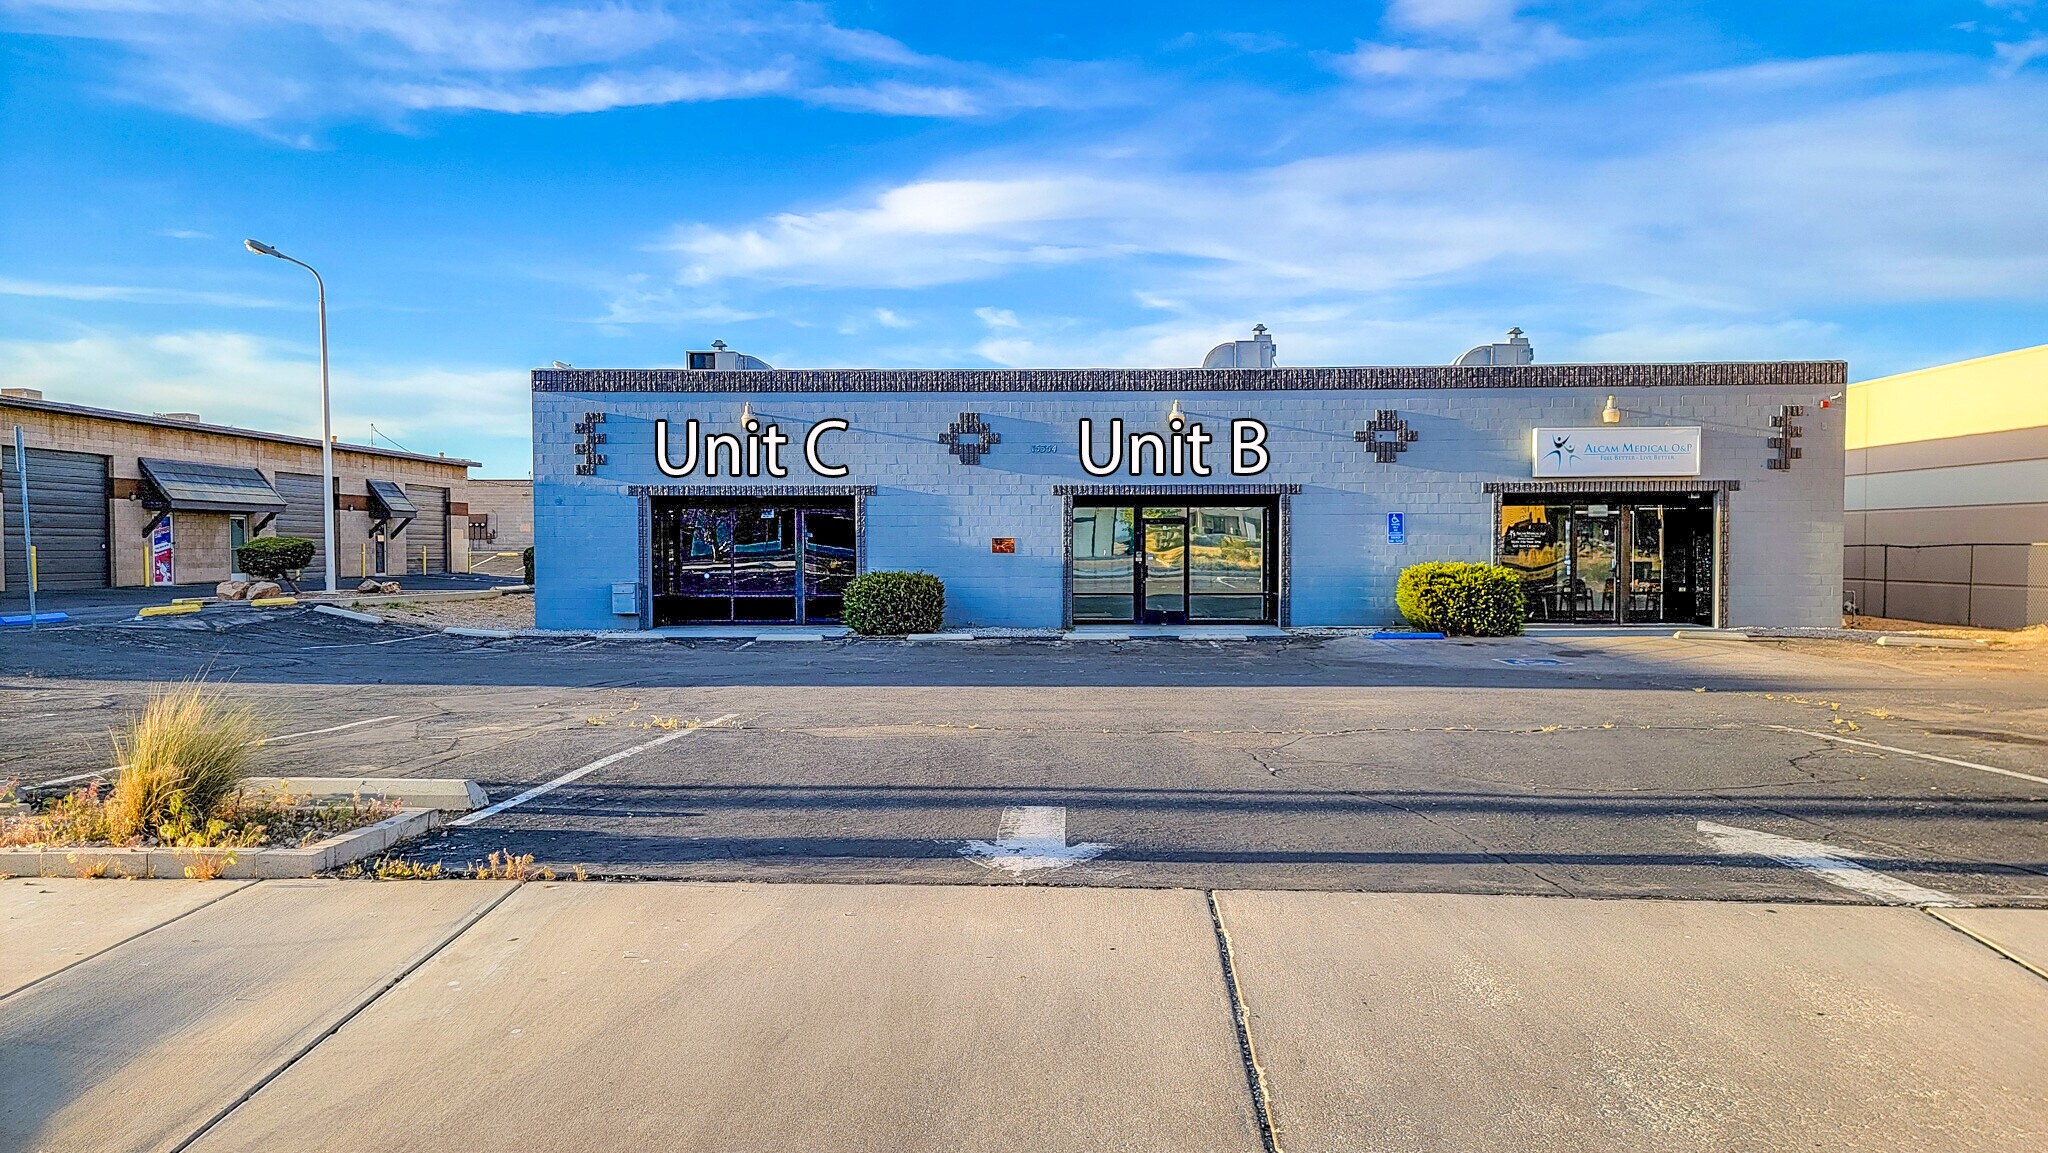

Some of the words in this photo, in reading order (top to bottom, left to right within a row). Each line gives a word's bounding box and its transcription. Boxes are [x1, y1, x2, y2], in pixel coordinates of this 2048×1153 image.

[1584, 443, 1619, 453] ALCAM
[1622, 443, 1668, 452] MEDICAL
[1671, 443, 1692, 452] O&P
